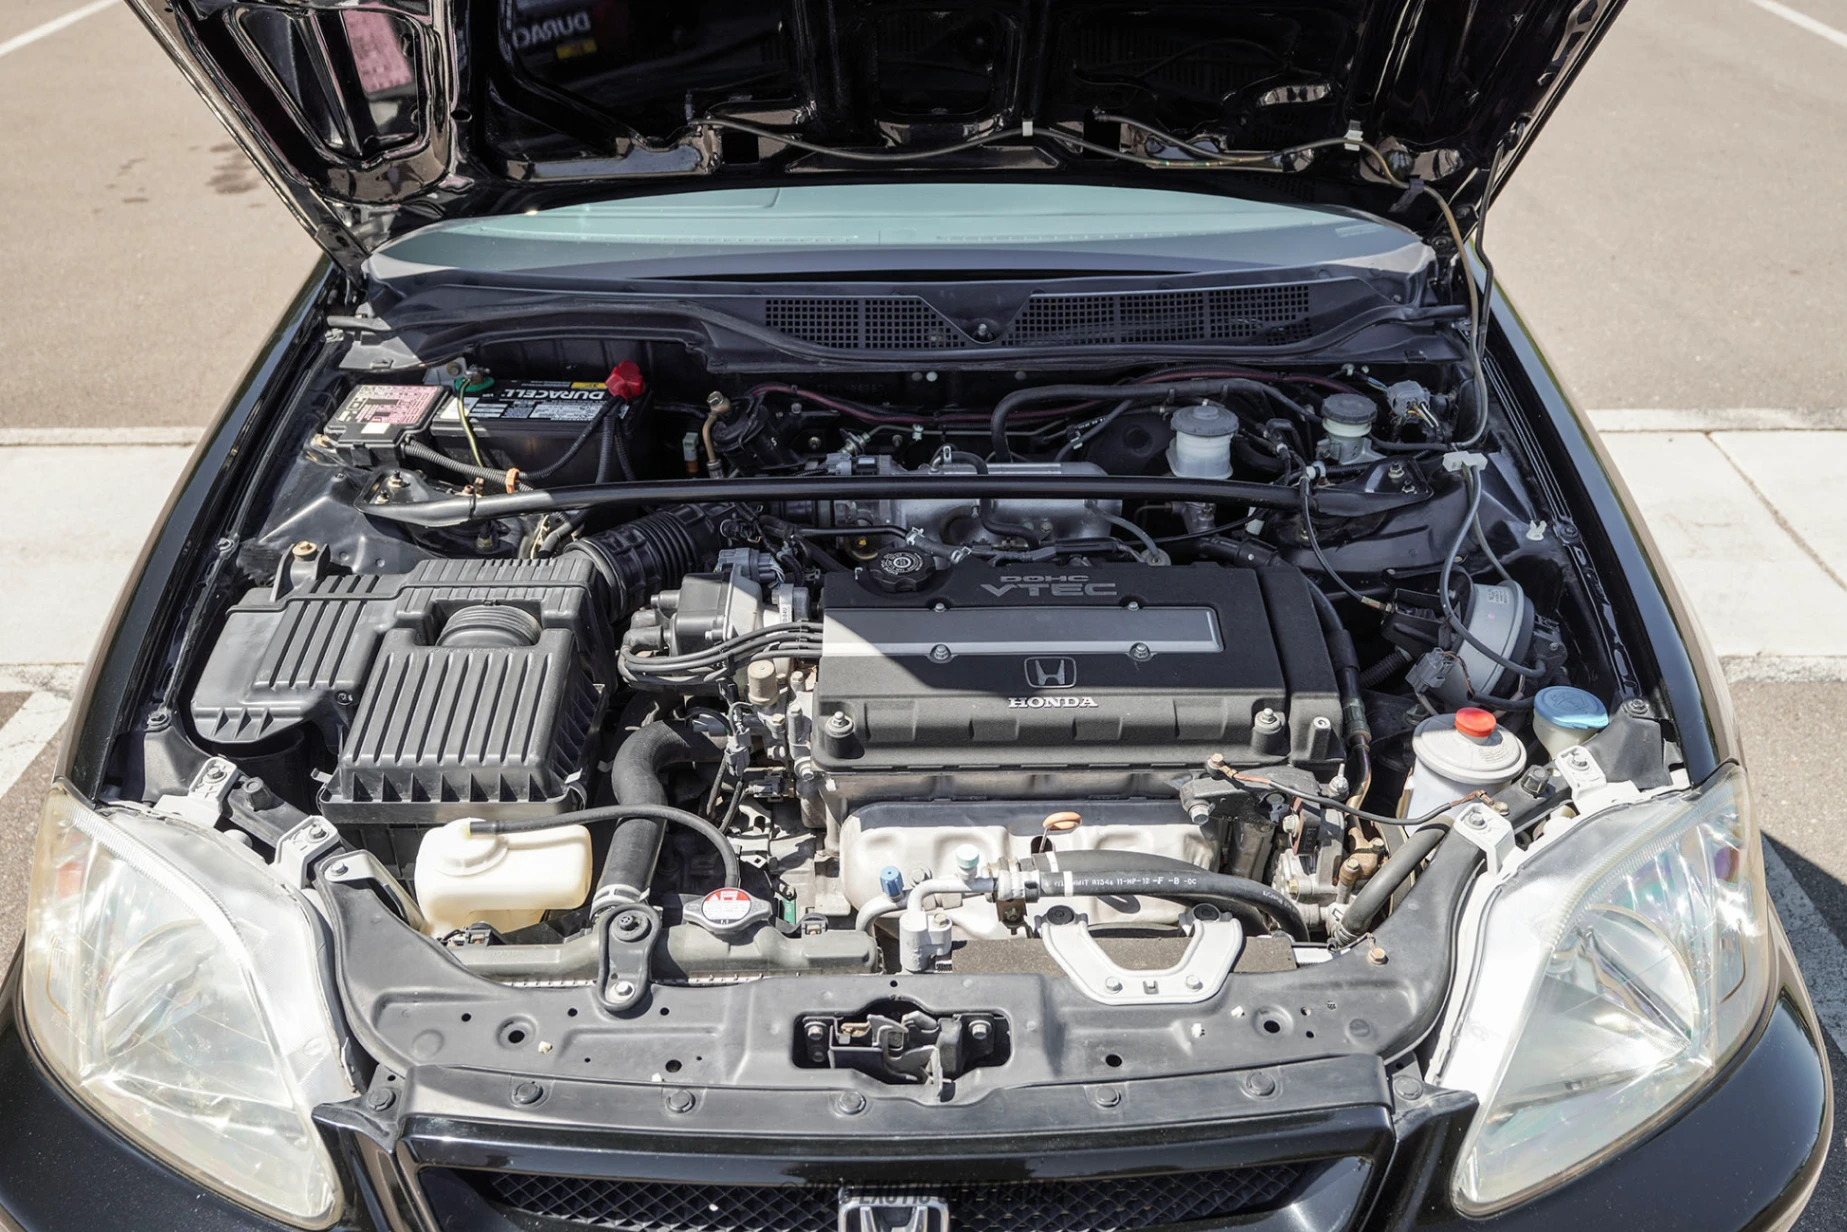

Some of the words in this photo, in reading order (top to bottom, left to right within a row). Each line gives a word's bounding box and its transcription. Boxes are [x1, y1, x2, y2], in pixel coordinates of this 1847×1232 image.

[504, 388, 606, 400] DURACELL
[980, 582, 1117, 597] VTEC
[1008, 696, 1099, 709] HONDA
